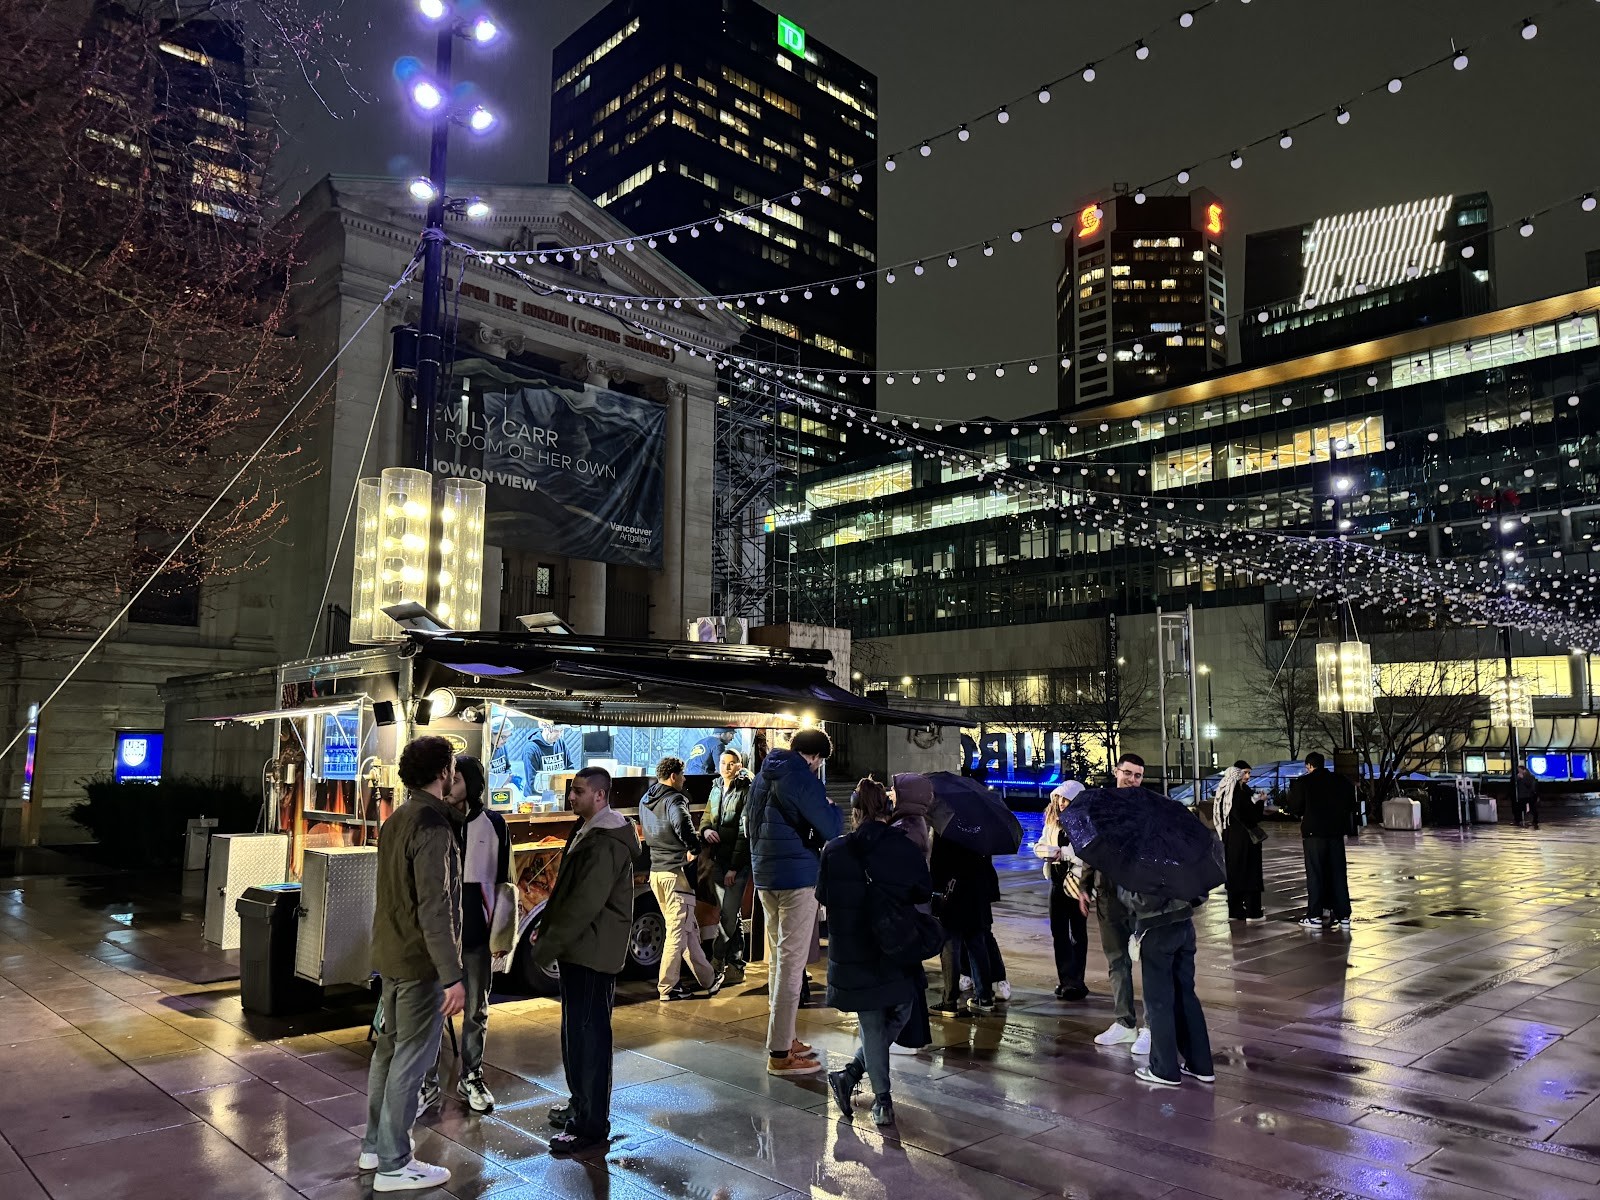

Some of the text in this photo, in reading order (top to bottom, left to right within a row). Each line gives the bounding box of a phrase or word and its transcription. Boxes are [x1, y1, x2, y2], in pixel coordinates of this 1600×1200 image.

[780, 20, 803, 51] TD
[494, 292, 518, 312] THE
[522, 301, 569, 329] HORIZON
[502, 420, 559, 449] CARR
[445, 428, 502, 455] ROOM
[508, 443, 533, 460] OF
[538, 449, 571, 470] HER
[576, 458, 616, 480] OWN
[469, 467, 494, 484] ON
[496, 471, 538, 492] VIEW
[610, 521, 652, 536] Vancouver
